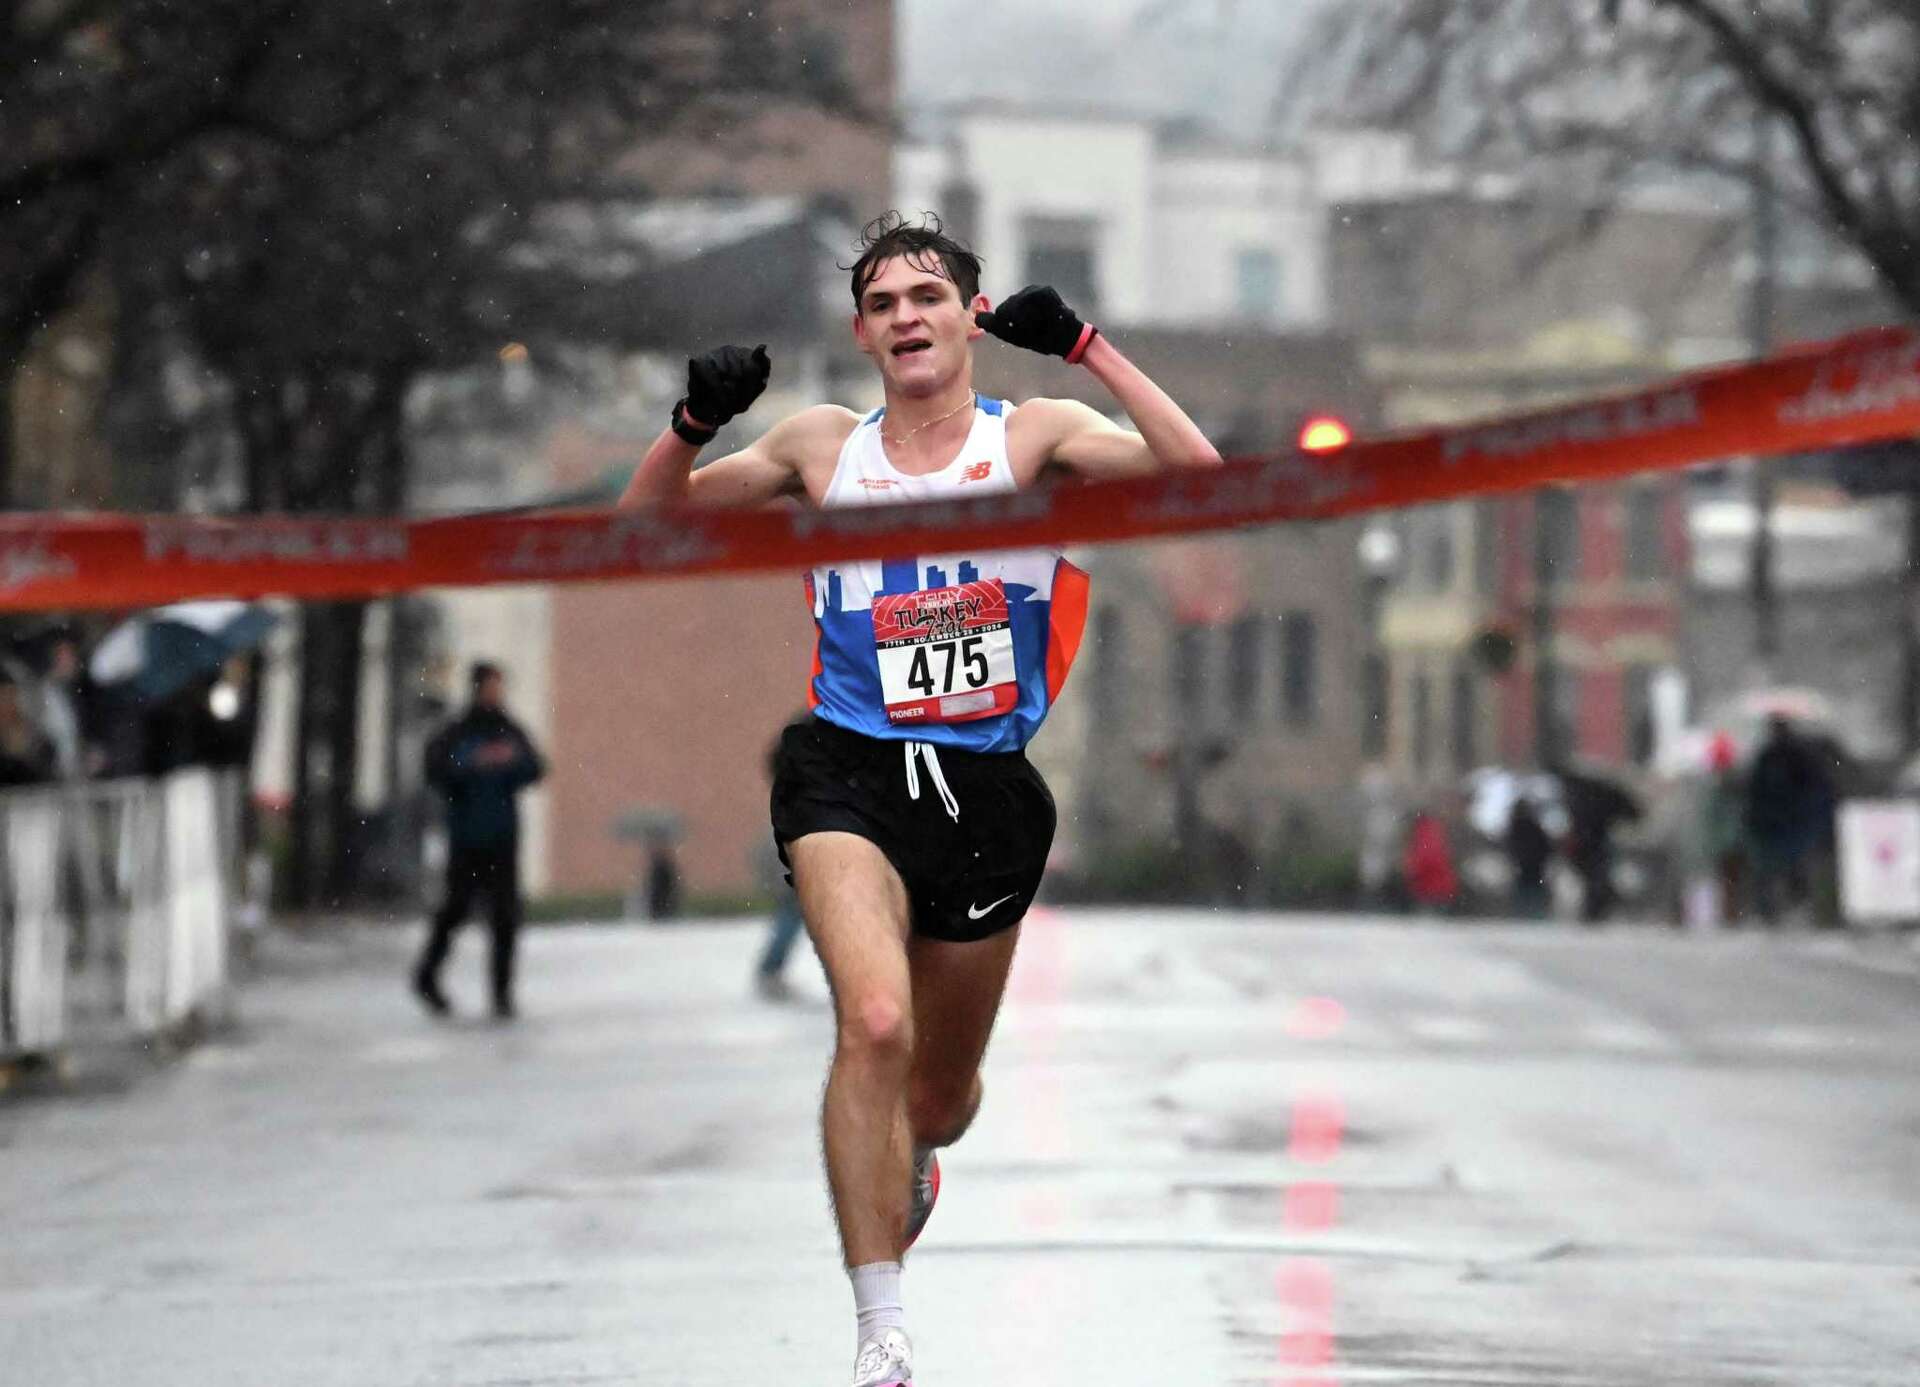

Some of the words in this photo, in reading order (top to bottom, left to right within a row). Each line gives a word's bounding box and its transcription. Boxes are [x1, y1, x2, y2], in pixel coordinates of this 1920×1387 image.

[895, 597, 983, 630] TURKEY
[981, 623, 1002, 633] 2024
[908, 636, 989, 696] 475
[890, 707, 925, 719] PIONEER
